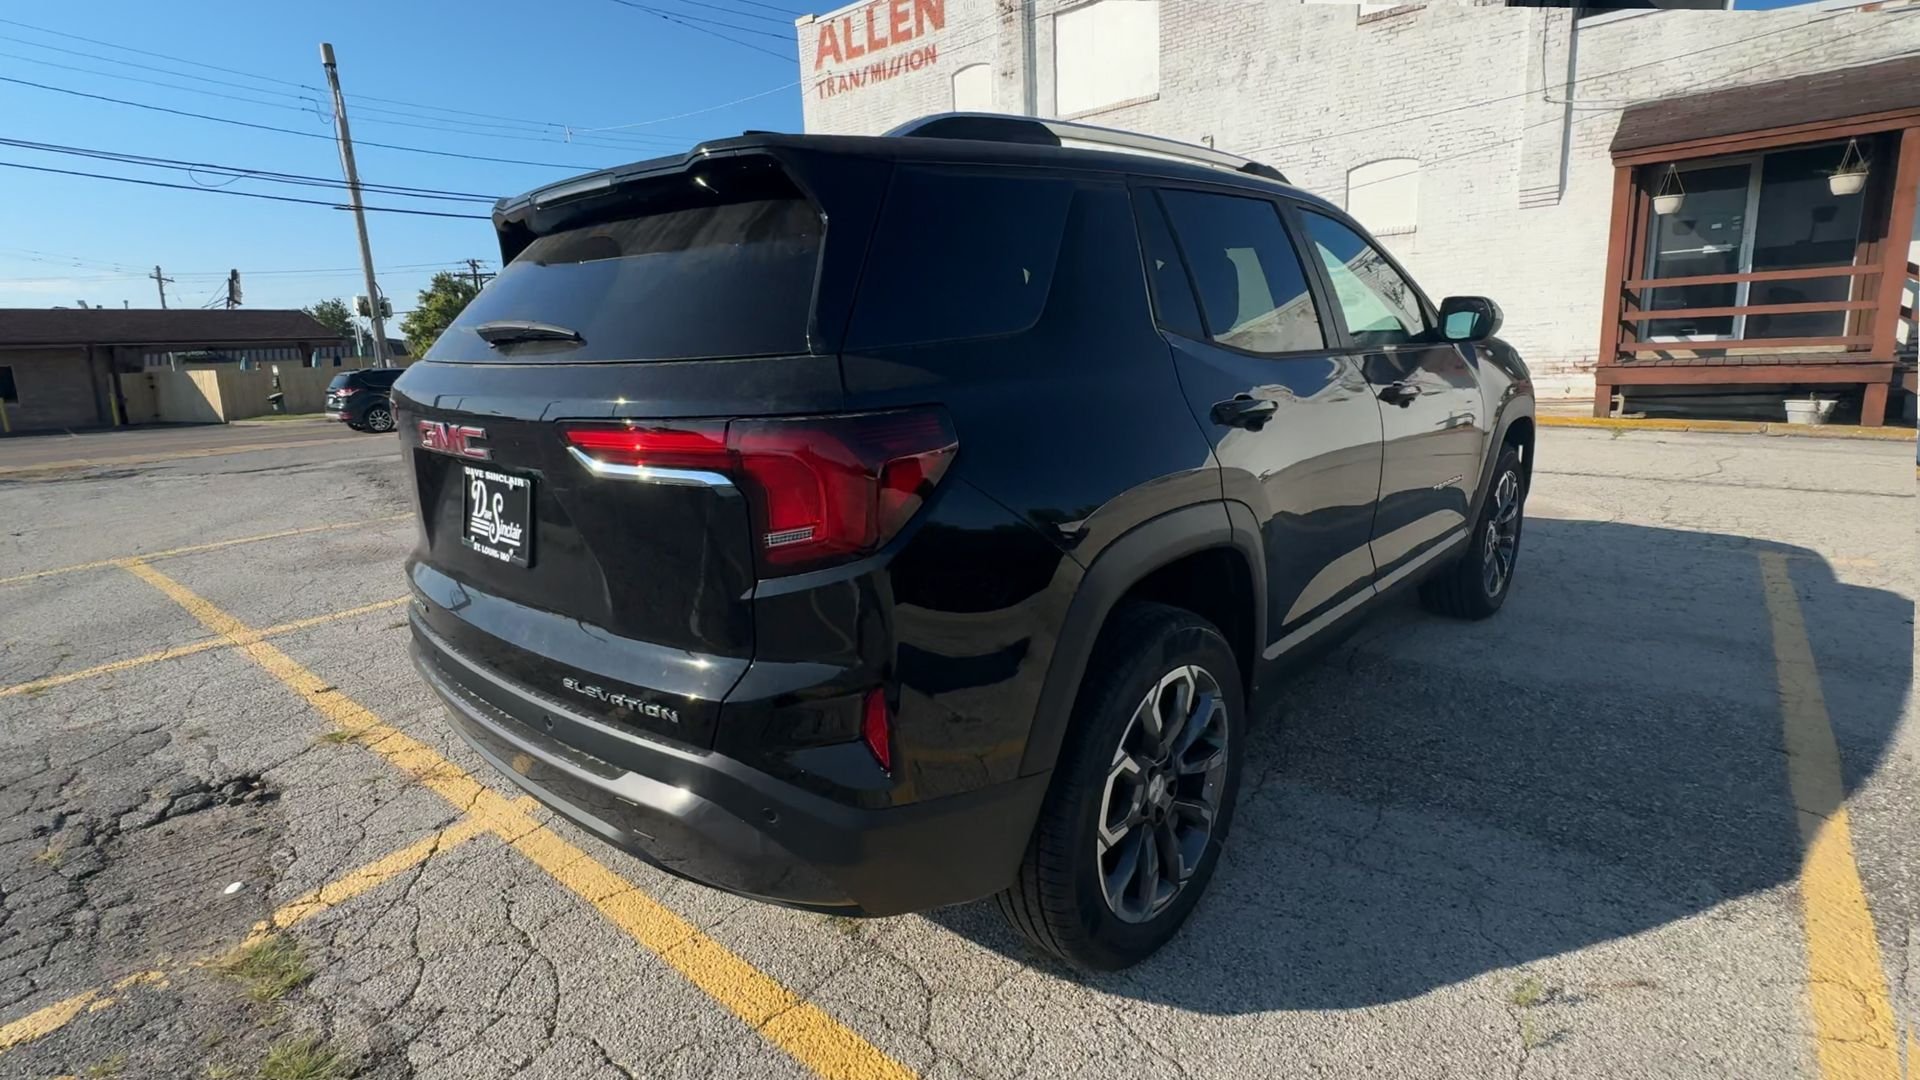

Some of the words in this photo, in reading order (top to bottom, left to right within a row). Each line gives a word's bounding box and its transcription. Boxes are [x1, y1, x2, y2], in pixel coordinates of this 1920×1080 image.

[814, 0, 945, 71] ALLEN
[816, 43, 937, 100] TRANSMISSION
[417, 420, 491, 460] GMC
[465, 466, 484, 479] DAVE
[485, 471, 524, 488] SINCLAIR
[562, 677, 679, 723] ELEVATION
